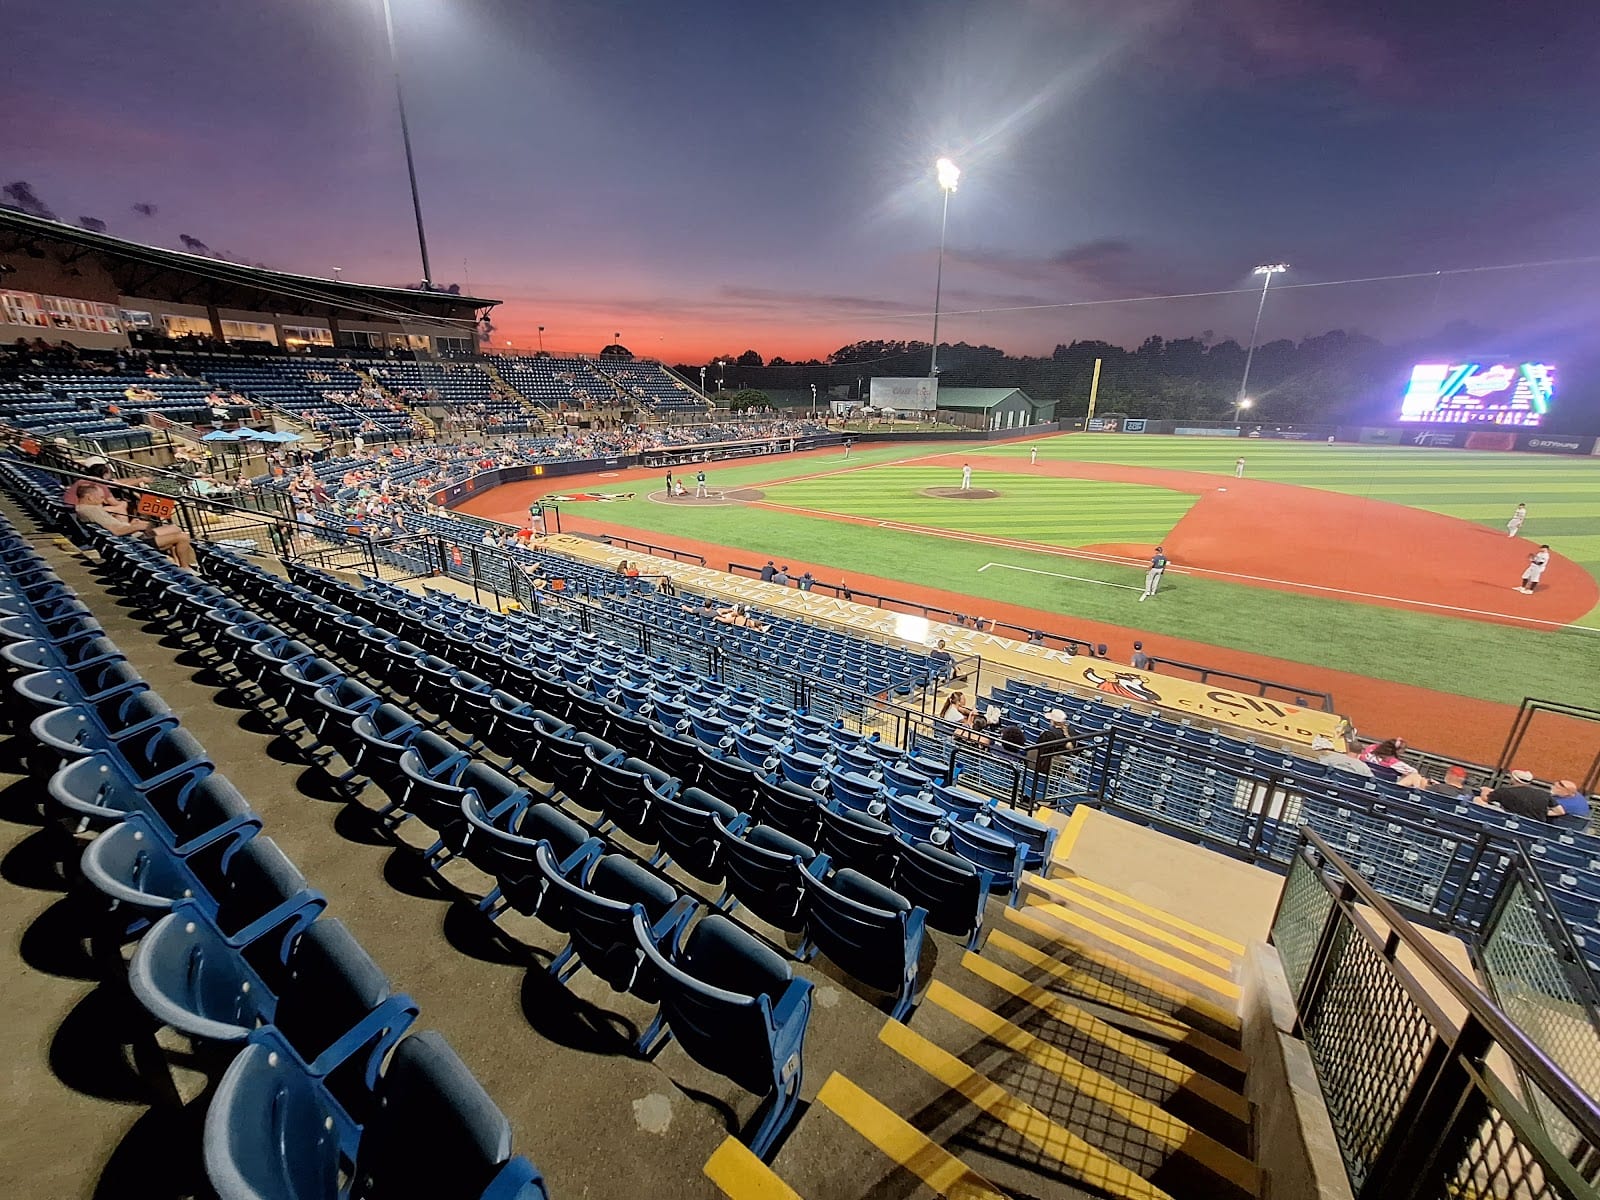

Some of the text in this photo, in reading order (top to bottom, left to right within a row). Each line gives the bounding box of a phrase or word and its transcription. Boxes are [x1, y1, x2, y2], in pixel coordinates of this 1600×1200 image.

[142, 501, 169, 516] 209
[690, 578, 975, 652] ROME EMPERRS
[723, 573, 876, 616] CLEANING
[884, 612, 1072, 665] PRTNER
[1178, 699, 1240, 717] CITY
